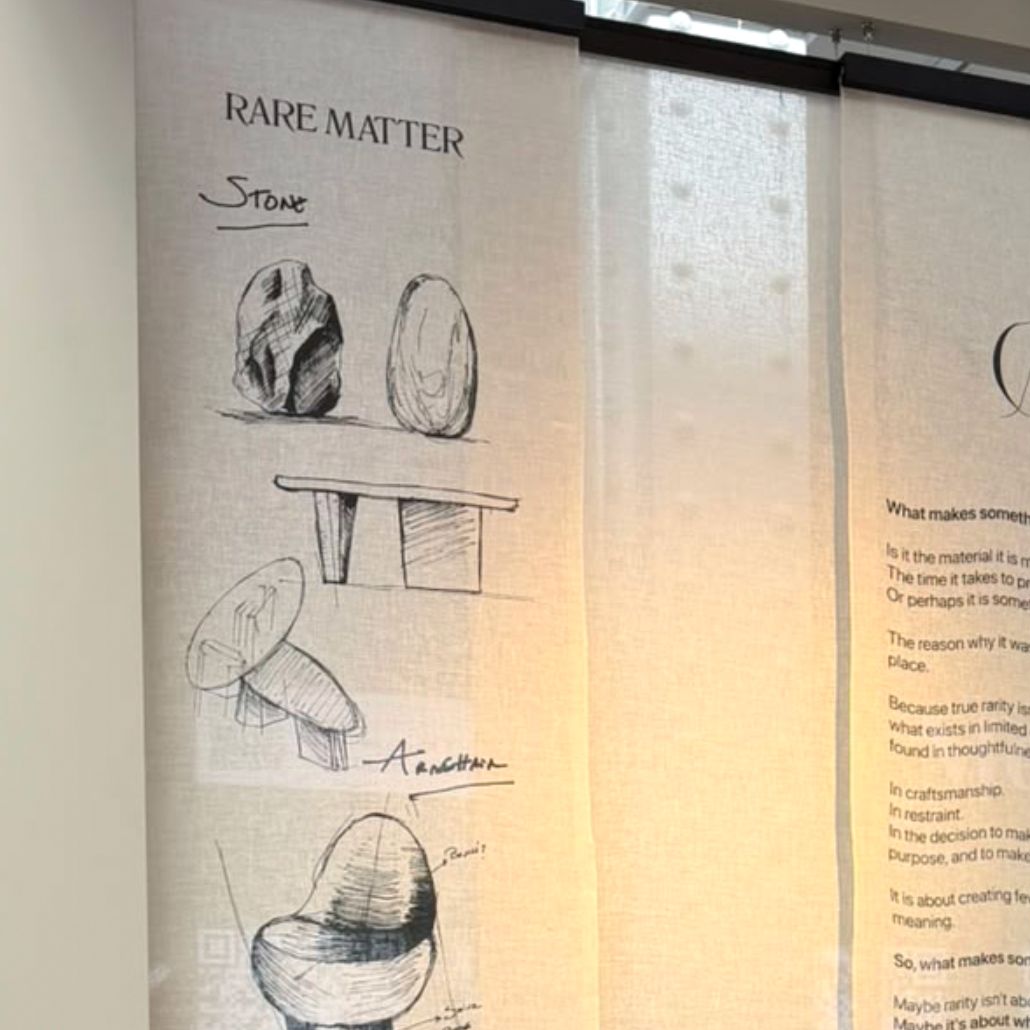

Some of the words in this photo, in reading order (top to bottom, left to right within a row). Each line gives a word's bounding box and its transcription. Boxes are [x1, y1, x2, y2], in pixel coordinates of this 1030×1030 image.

[226, 92, 317, 132] RARE
[325, 107, 464, 158] MATTER
[886, 499, 925, 521] What
[929, 507, 977, 522] makes
[887, 543, 899, 559] Is
[902, 546, 910, 561] it
[913, 549, 936, 565] the
[939, 550, 993, 565] material
[996, 550, 1004, 563] it
[1007, 551, 1018, 566] is
[888, 566, 914, 584] The
[917, 571, 947, 586] time
[951, 572, 959, 585] it
[962, 571, 998, 585] takes
[1001, 572, 1015, 586] to
[887, 588, 903, 603] Or
[908, 593, 964, 611] perhaps
[967, 594, 976, 606] it
[979, 593, 990, 606] is
[889, 630, 915, 650] The
[918, 637, 964, 652] reason
[967, 636, 994, 651] why
[998, 636, 1007, 649] it
[888, 655, 930, 674] place.
[889, 695, 948, 716] Because
[951, 700, 978, 714] true
[981, 699, 1015, 715] rarity
[889, 720, 923, 737] what
[926, 724, 966, 737] exists
[969, 722, 980, 736] in
[984, 721, 1027, 737] limited
[889, 740, 929, 759] found
[932, 744, 945, 759] in
[890, 783, 902, 797] In
[906, 784, 1004, 801] craftsmanship.
[890, 804, 902, 819] In
[905, 808, 964, 823] restraint.
[889, 825, 902, 839] In
[904, 830, 927, 844] the
[930, 828, 988, 844] decision
[990, 827, 1003, 840] to
[889, 848, 948, 868] purpose,
[951, 848, 977, 864] and
[981, 848, 994, 861] to
[890, 888, 899, 903] It
[902, 891, 913, 905] is
[917, 892, 955, 908] about
[958, 889, 1012, 906] creating
[893, 913, 954, 929] meaning.
[894, 953, 917, 972] So,
[920, 956, 955, 972] what
[958, 953, 1004, 969] makes
[894, 994, 941, 1015] Maybe
[944, 996, 978, 1013] rarity
[981, 994, 1007, 1008] isn't
[970, 1015, 1010, 1030] about
